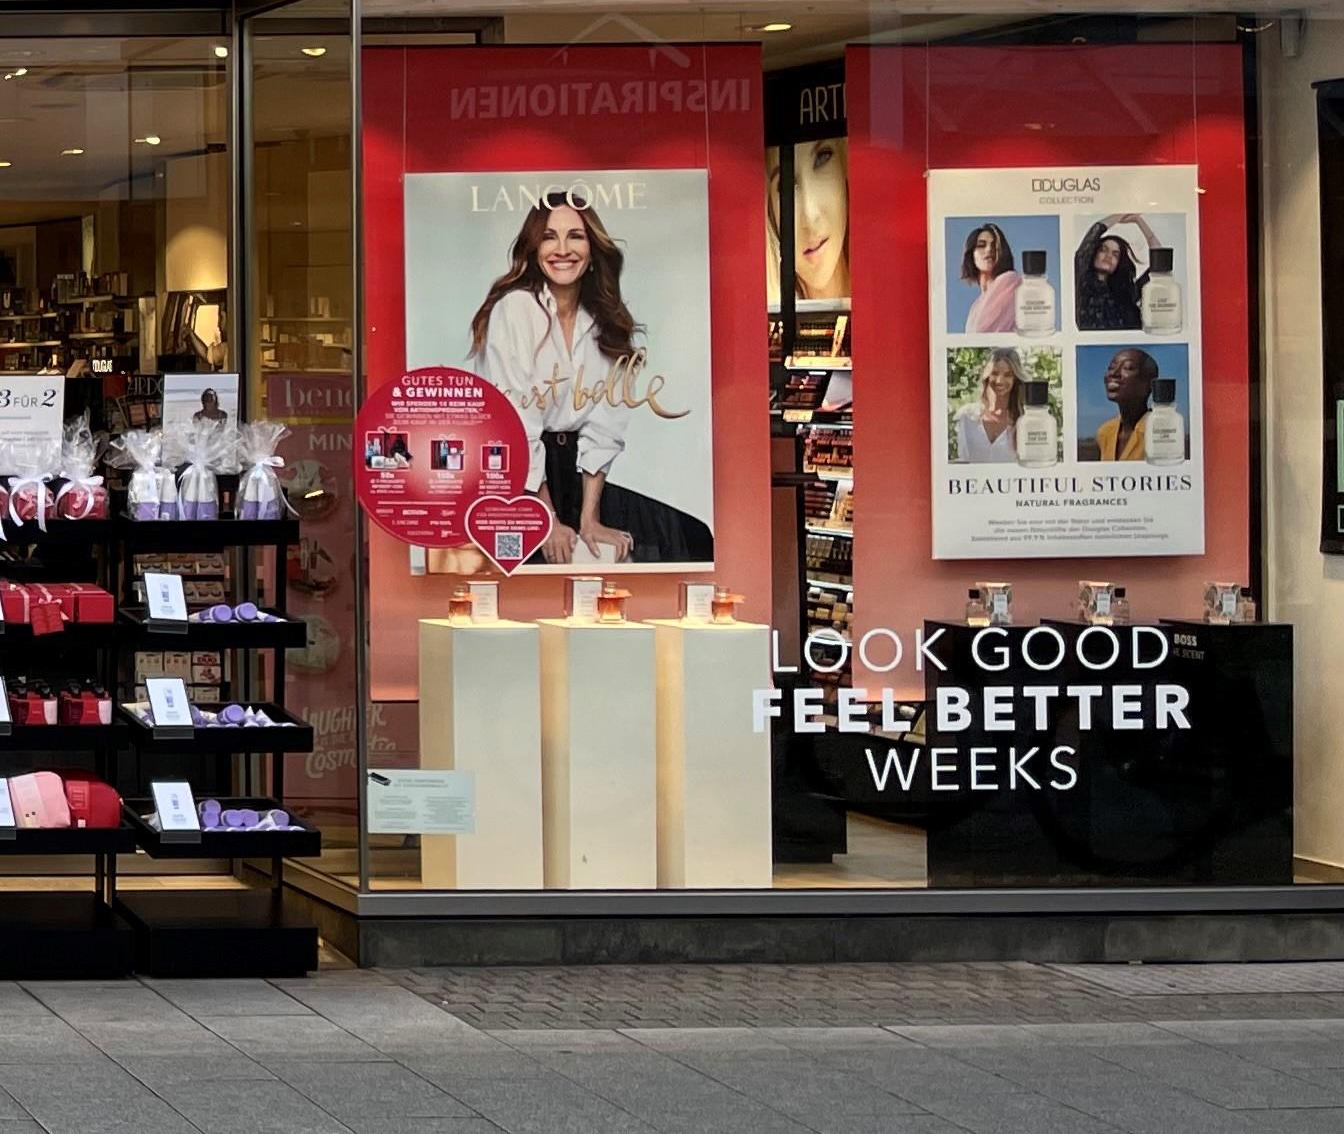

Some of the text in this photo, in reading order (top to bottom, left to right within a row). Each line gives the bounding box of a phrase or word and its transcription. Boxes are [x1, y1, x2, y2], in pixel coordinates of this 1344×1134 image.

[1031, 177, 1101, 193] DOUGLAS
[470, 178, 648, 213] LANCÔME
[1039, 195, 1095, 205] COLLECTION
[401, 375, 474, 386] GUTES TUN
[392, 386, 483, 398] & GEWINNEN
[13, 394, 38, 408] FÜR
[948, 474, 1193, 495] BEAUTIFUL STORIES
[1015, 496, 1128, 508] NATURAL FRAGRANCES
[1173, 633, 1198, 647] BOSS
[771, 626, 1169, 674] LOOK GOOD
[751, 684, 1192, 734] FEEL BETTER
[864, 745, 1079, 792] WEEKS
